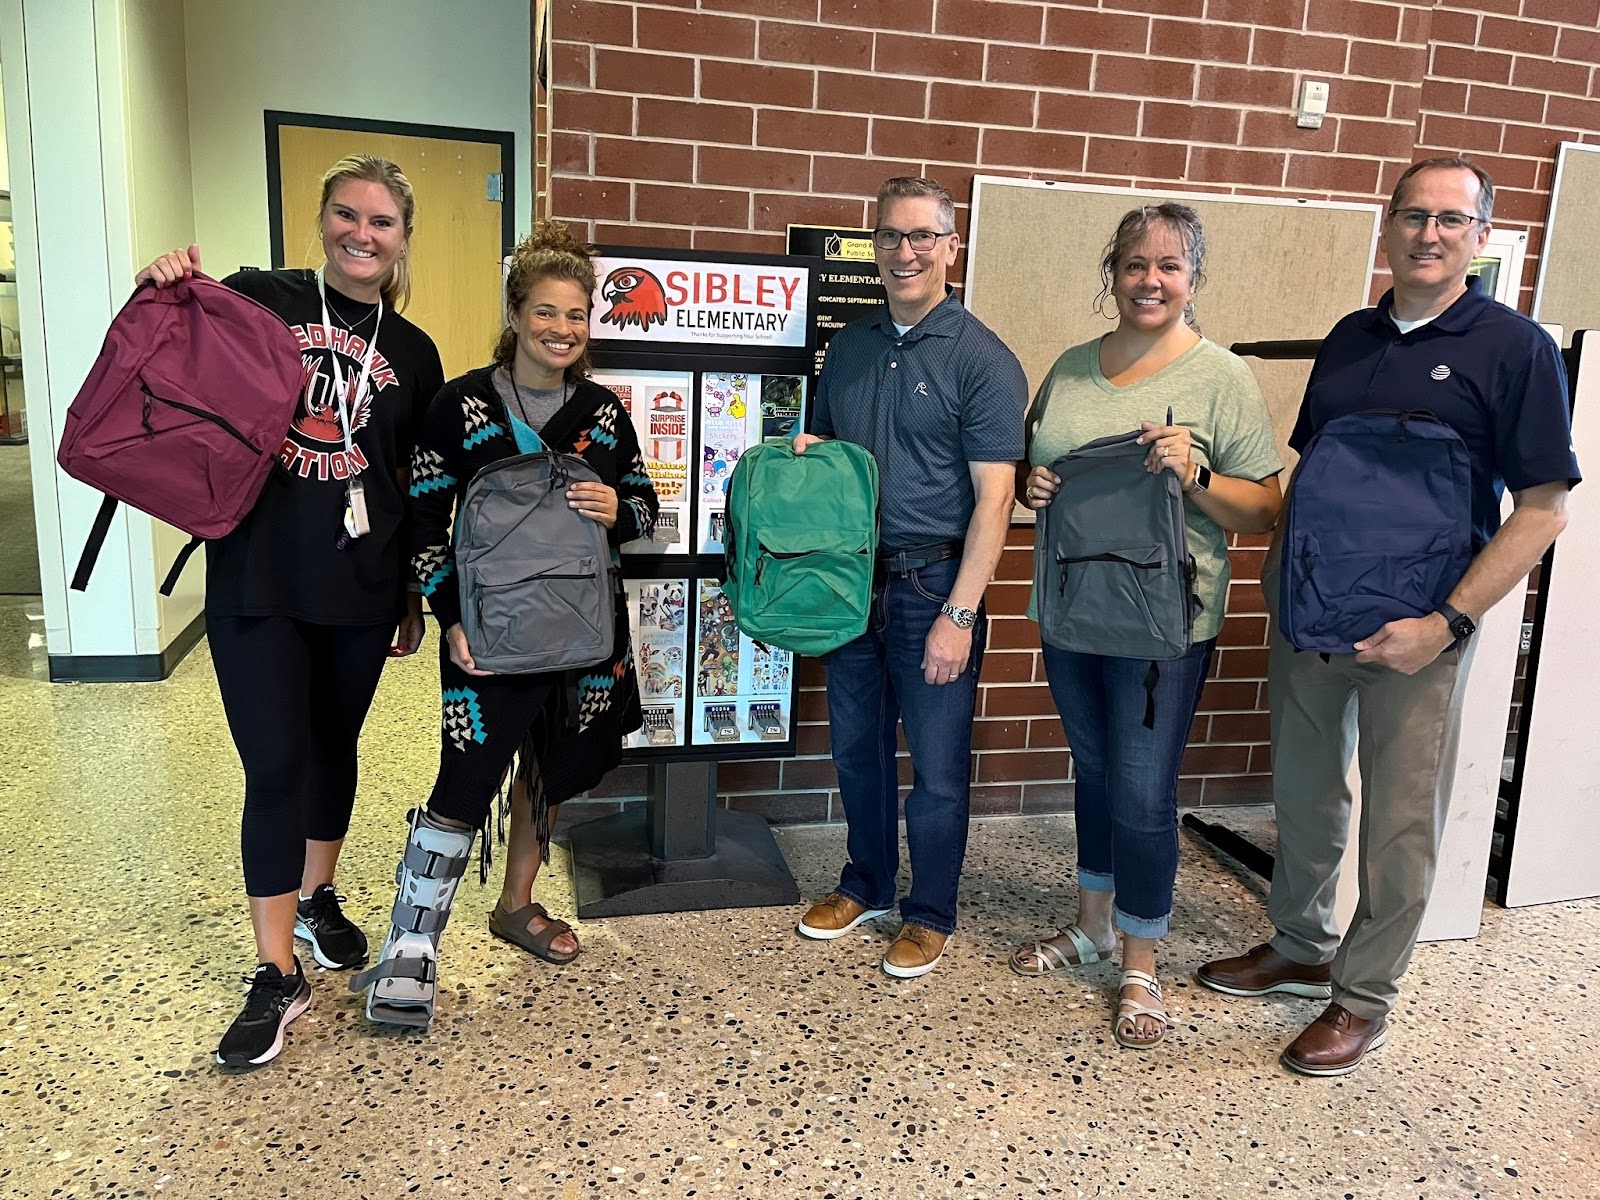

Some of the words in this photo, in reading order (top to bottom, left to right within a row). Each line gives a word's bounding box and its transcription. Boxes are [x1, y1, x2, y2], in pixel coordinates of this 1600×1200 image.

[819, 273, 828, 282] Y
[828, 274, 885, 285] ELEMENTAR
[666, 271, 801, 311] SIBLEY
[847, 297, 877, 305] SEPTEMBER
[676, 309, 788, 332] ELEMENTARY
[716, 332, 743, 340] Supporting
[650, 414, 685, 423] SURPRISE
[650, 423, 685, 435] INSIDE
